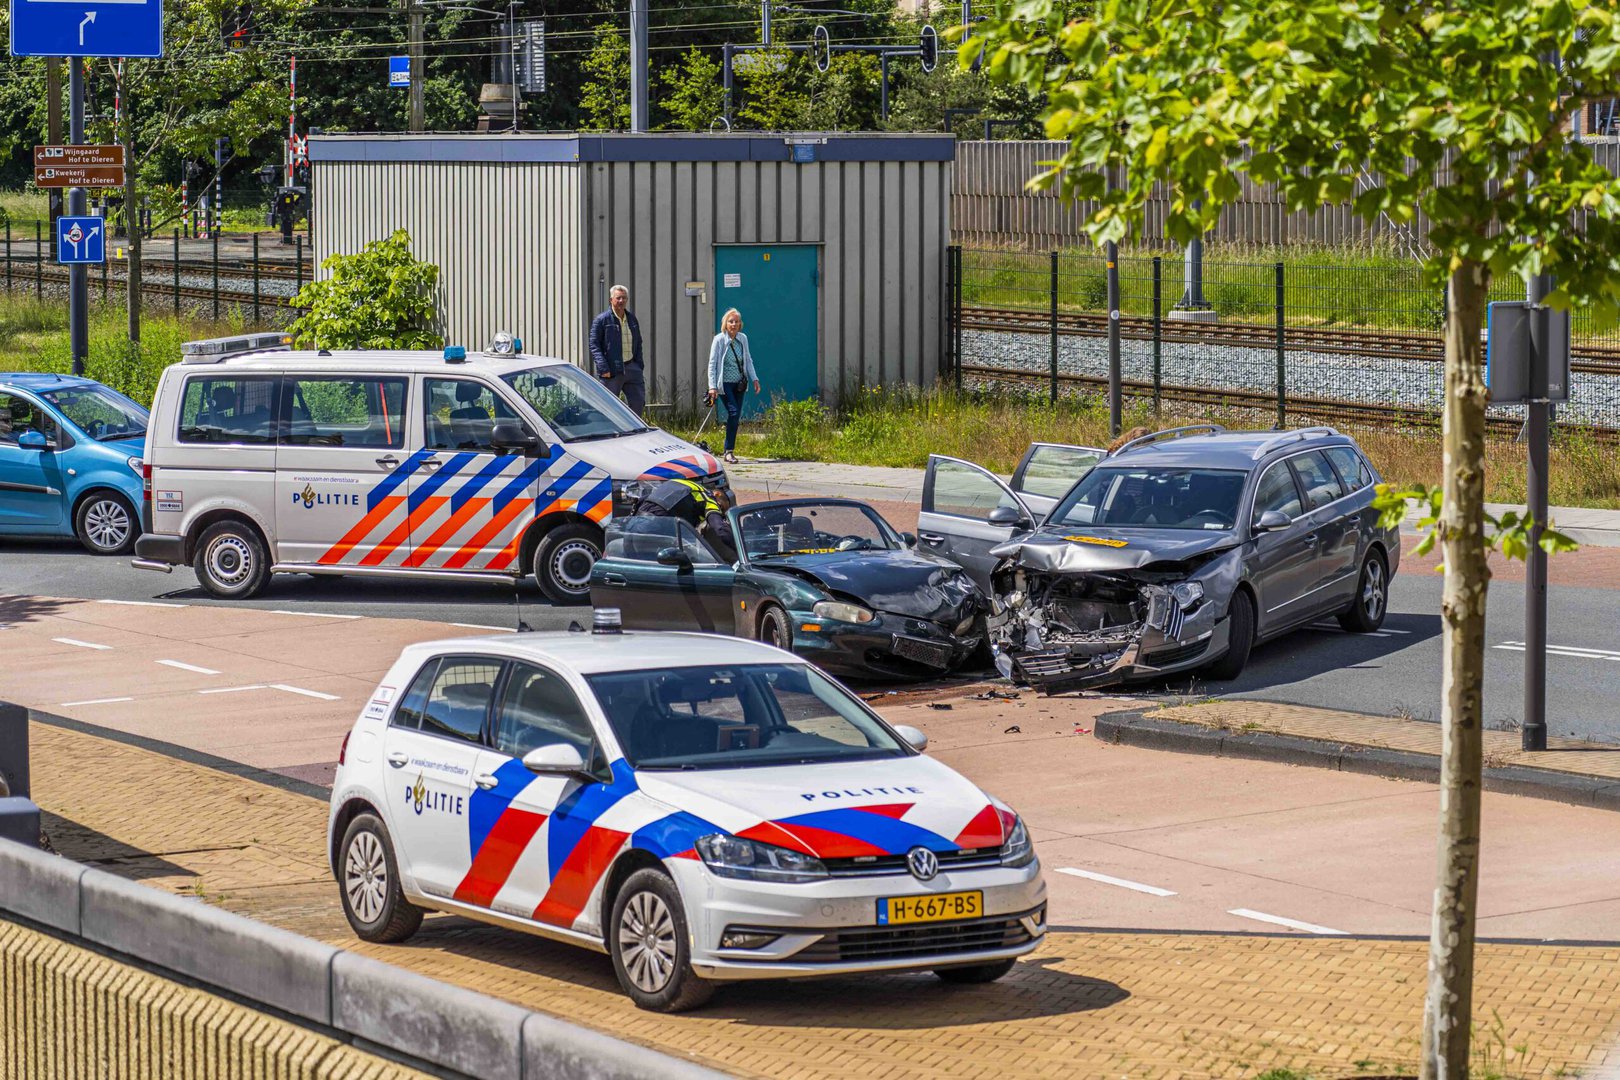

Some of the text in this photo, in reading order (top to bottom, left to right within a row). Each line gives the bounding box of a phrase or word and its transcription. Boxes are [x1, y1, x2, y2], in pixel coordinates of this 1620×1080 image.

[293, 492, 359, 509] POLITIE
[405, 785, 463, 816] POLITIE
[800, 786, 925, 801] POLITIE
[894, 895, 976, 919] H-667-BS
